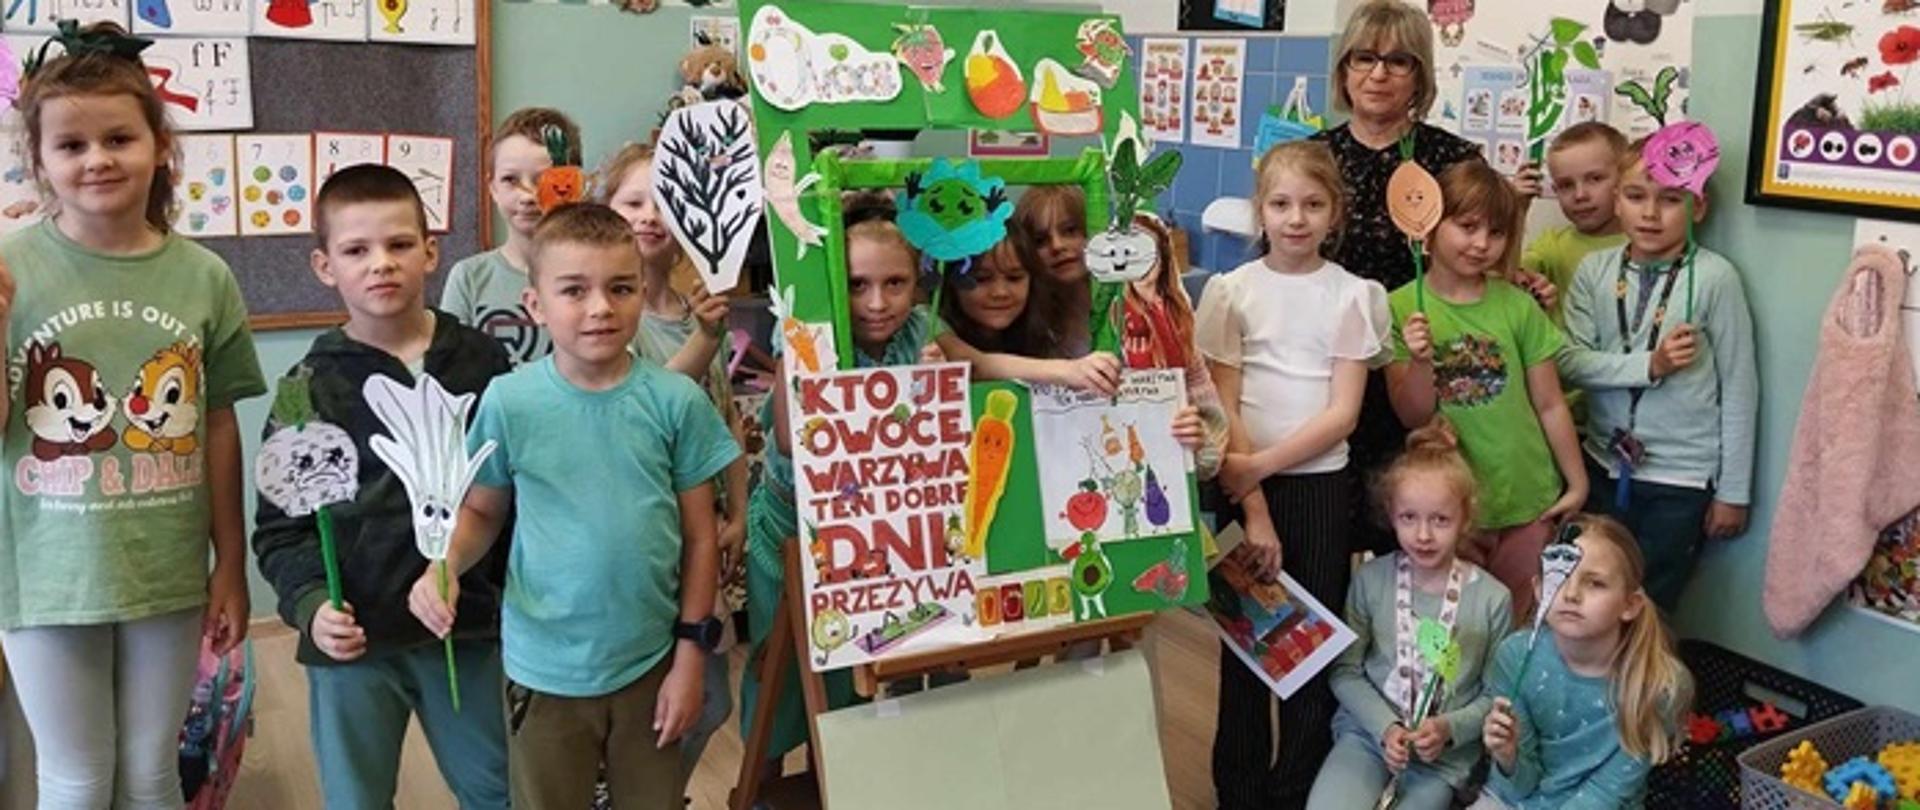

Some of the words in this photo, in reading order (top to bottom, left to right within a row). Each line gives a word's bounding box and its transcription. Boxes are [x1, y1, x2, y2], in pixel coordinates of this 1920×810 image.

[251, 143, 263, 160] 7
[329, 140, 339, 155] 8
[400, 143, 411, 157] 9
[112, 300, 133, 319] IS
[141, 305, 186, 338] OUT
[801, 370, 899, 415] KTO
[911, 367, 966, 405] JE
[100, 455, 127, 495] &
[802, 448, 970, 494] WARZYWA
[809, 493, 876, 520] TEN
[816, 512, 948, 585] DNI
